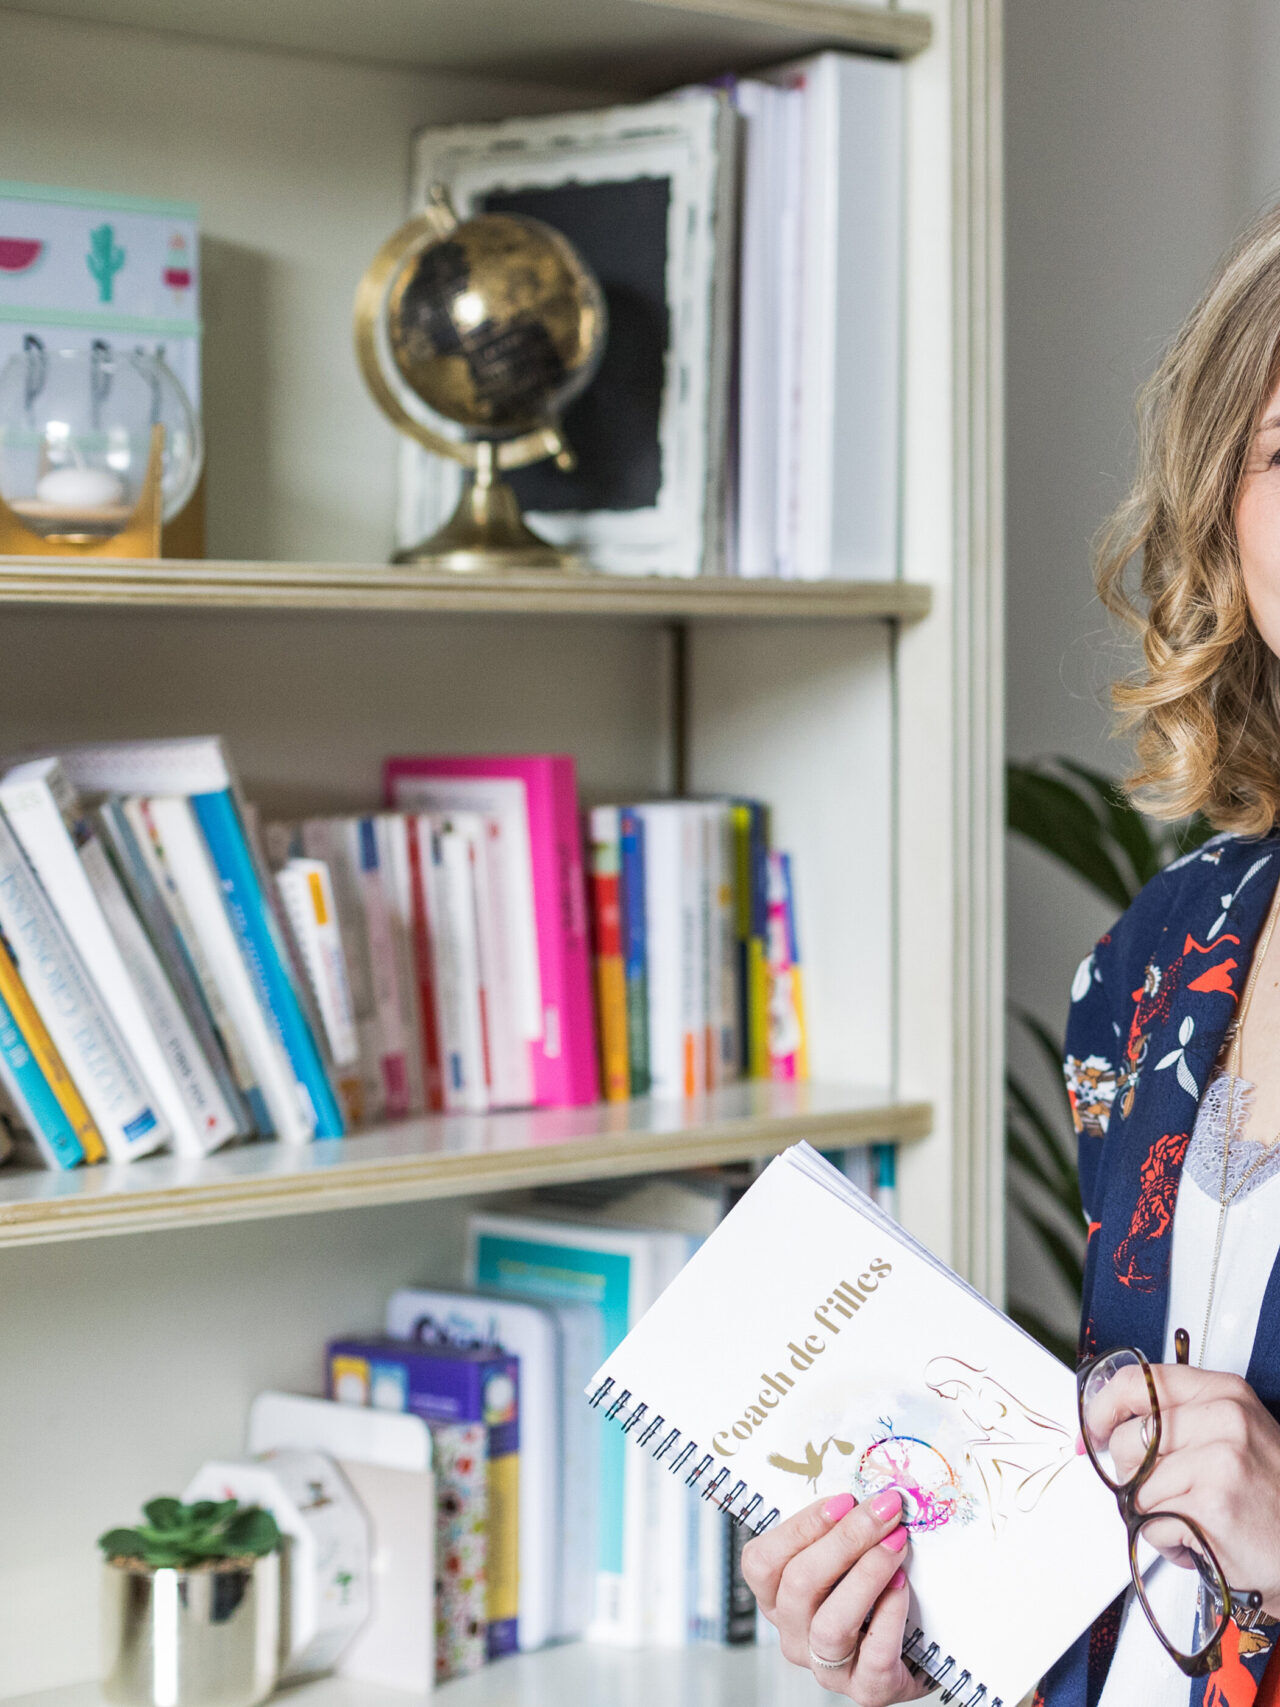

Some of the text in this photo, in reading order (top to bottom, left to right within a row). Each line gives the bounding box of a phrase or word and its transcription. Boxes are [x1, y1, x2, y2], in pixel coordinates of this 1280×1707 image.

[712, 1257, 892, 1456] Coach de filles
